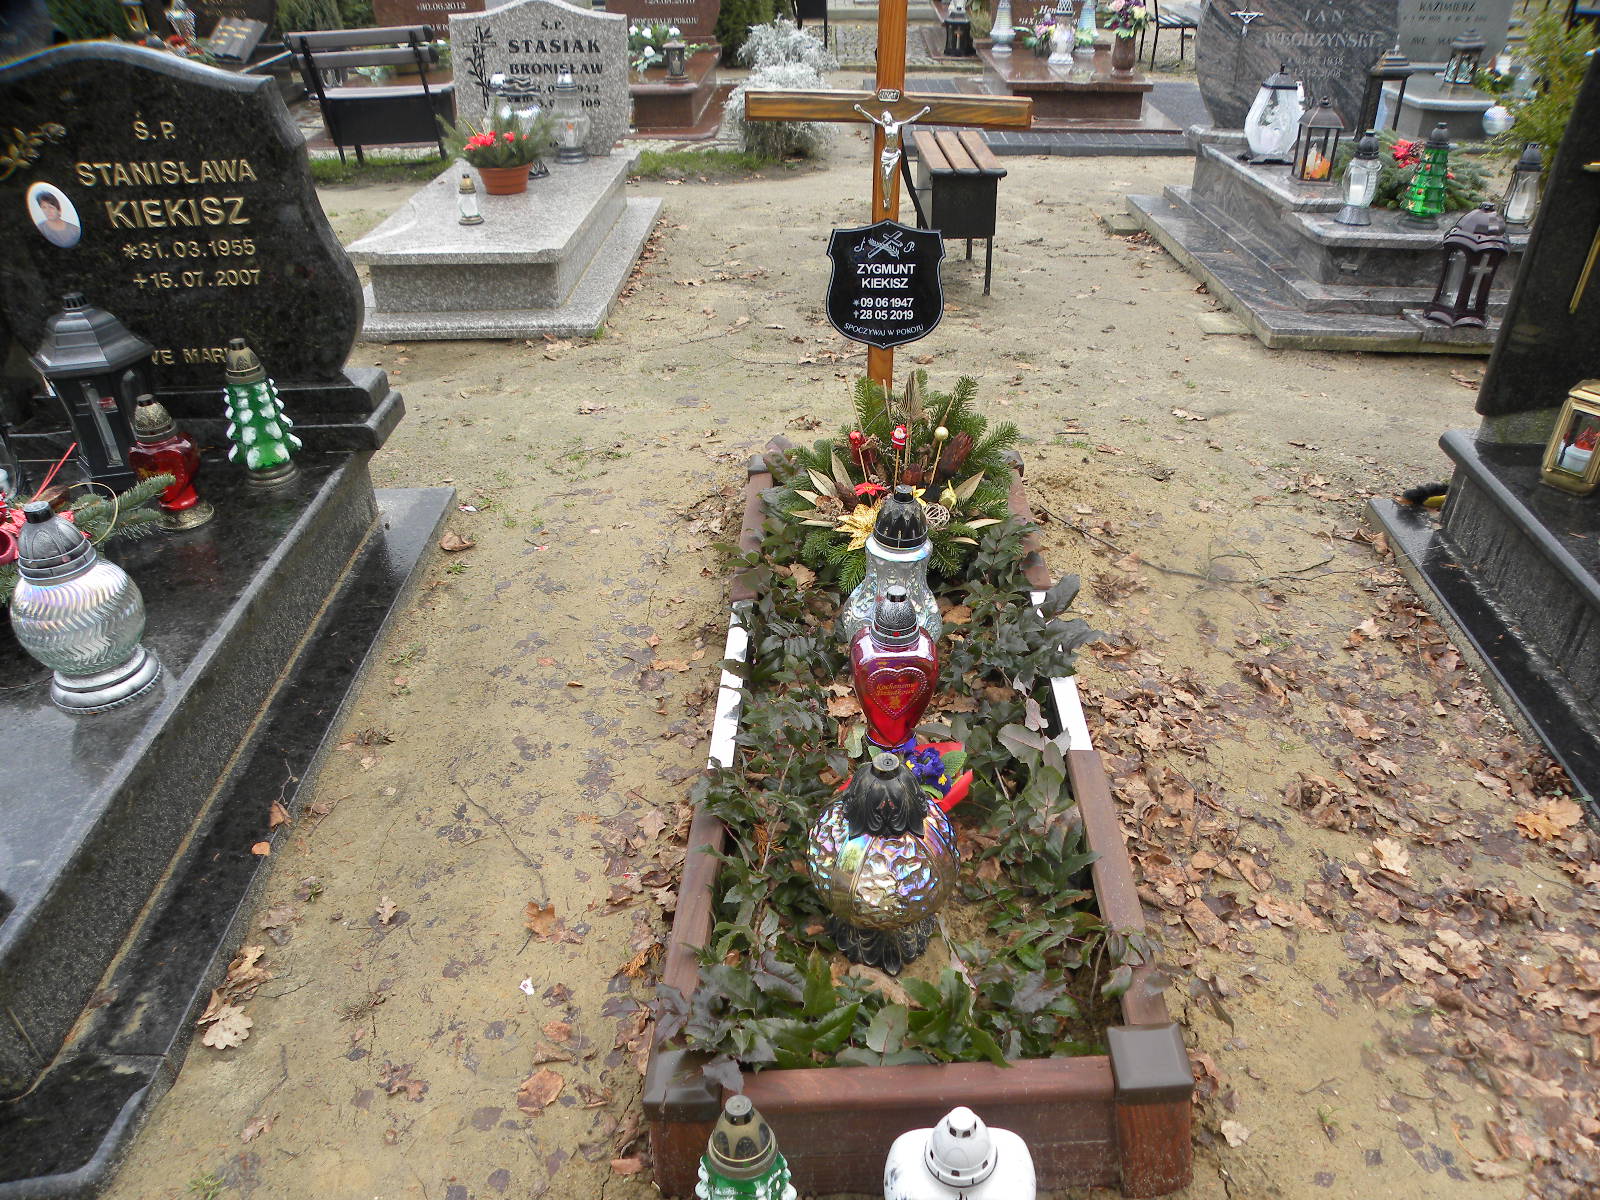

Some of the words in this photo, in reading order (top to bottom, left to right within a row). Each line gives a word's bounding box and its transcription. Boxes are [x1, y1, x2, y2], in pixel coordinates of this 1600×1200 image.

[508, 40, 601, 53] STASIAK
[75, 159, 258, 187] STANISŁAWA
[105, 197, 250, 229] KIEKISZ
[856, 263, 917, 275] ZYGMUNT
[861, 277, 909, 289] KIEKISZ
[860, 297, 874, 308] 09
[875, 297, 889, 308] 06
[889, 297, 914, 308] 1947
[859, 309, 873, 320] 28
[874, 309, 888, 320] 05
[889, 309, 914, 320] 2019
